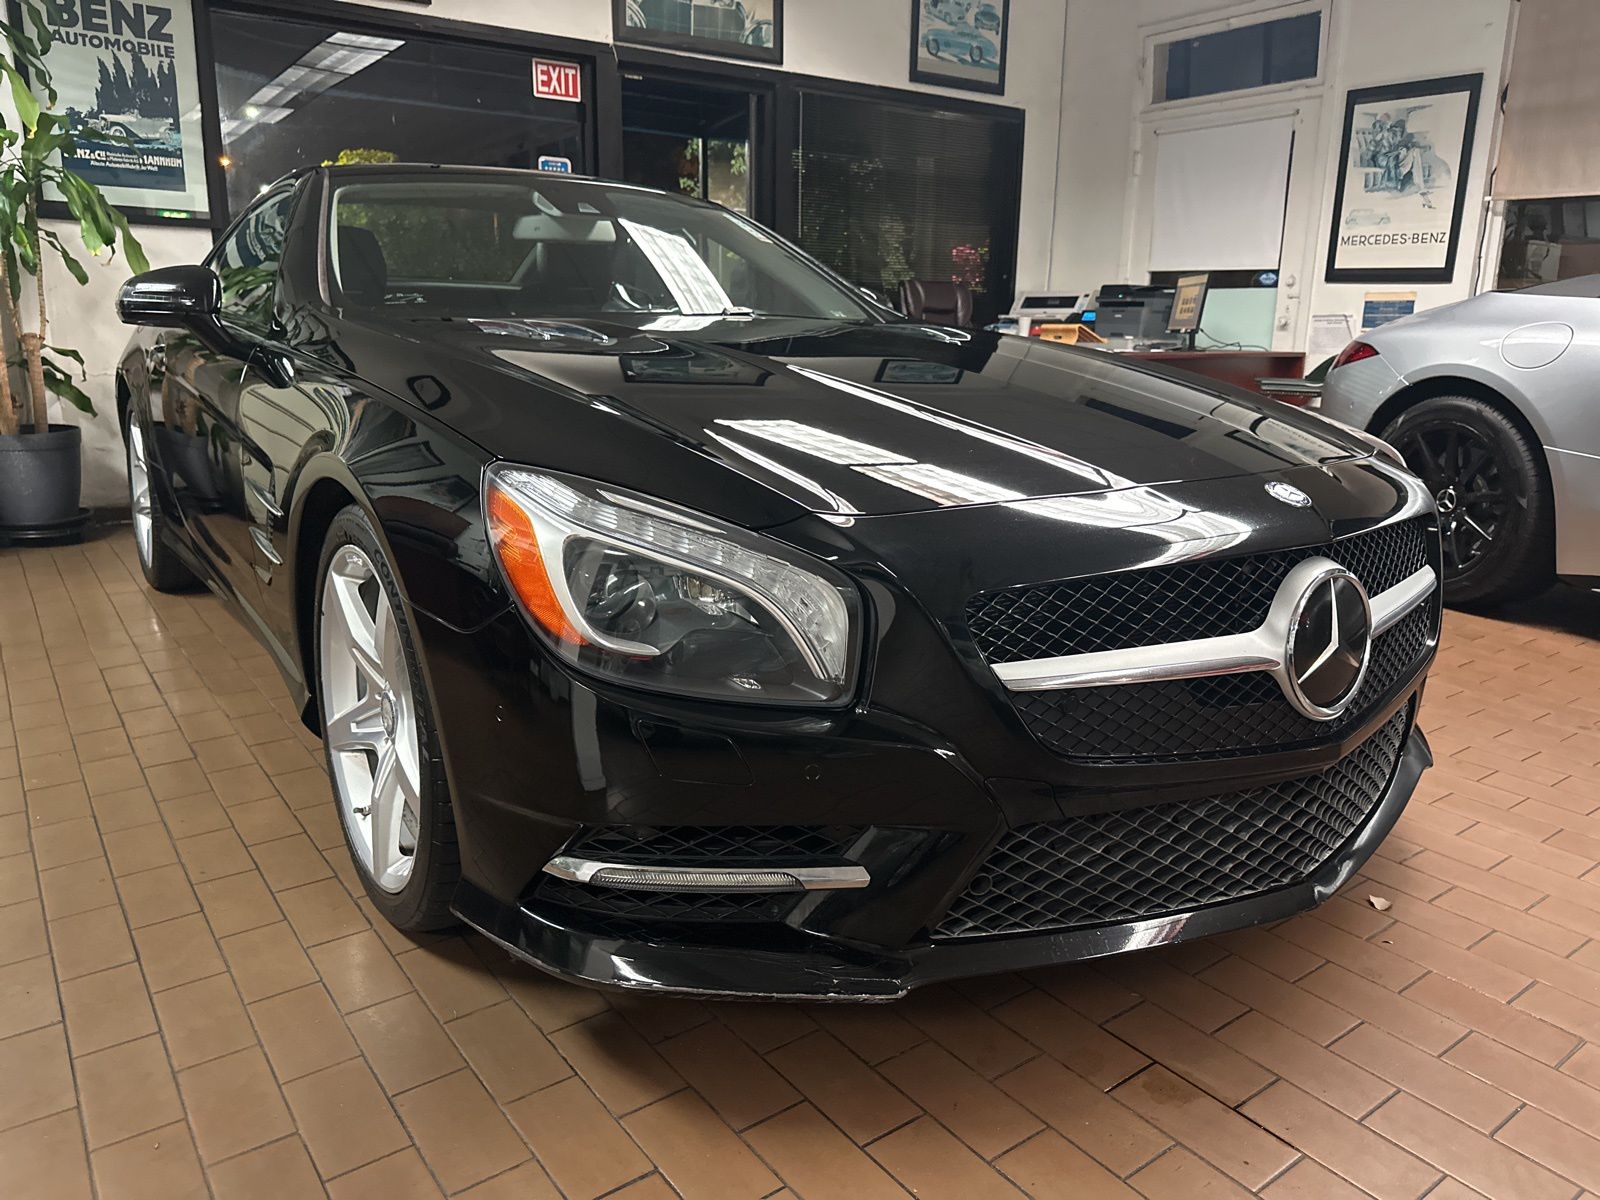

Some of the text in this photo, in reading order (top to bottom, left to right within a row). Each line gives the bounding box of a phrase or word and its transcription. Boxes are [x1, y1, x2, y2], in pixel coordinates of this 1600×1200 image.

[46, 0, 173, 43] BENZ
[50, 29, 175, 59] AUTOMOBILE
[537, 64, 576, 95] EXIT
[1340, 232, 1446, 246] MERCEDES-BENZ
